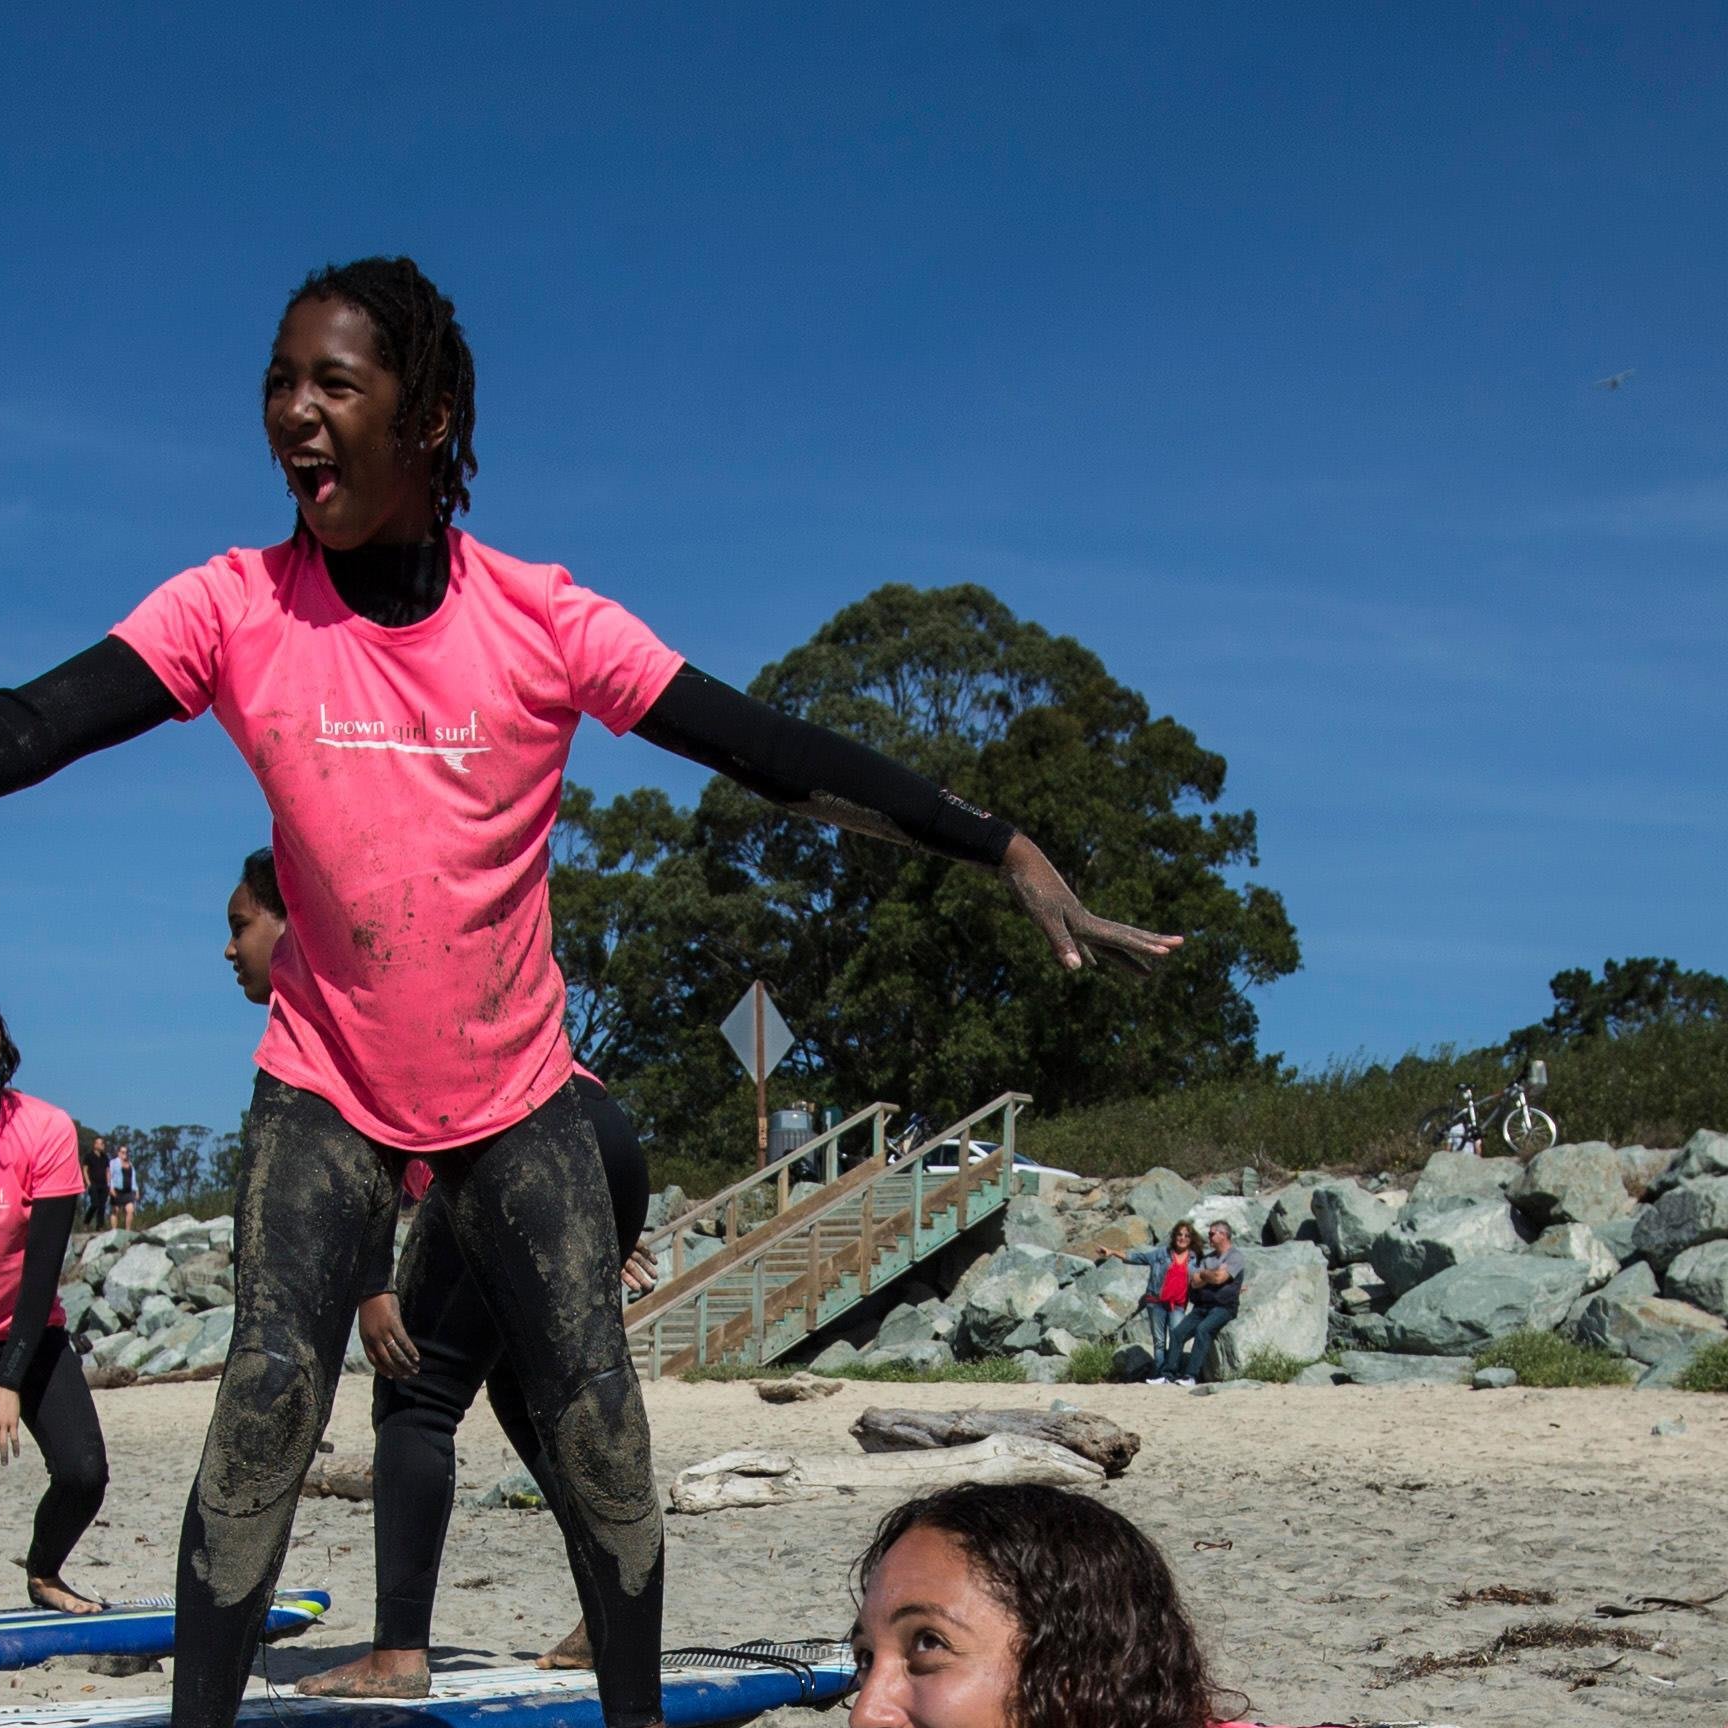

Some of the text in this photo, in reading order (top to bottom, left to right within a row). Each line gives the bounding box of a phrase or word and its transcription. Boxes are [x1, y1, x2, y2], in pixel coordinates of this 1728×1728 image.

[320, 703, 478, 743] brown girl surf
